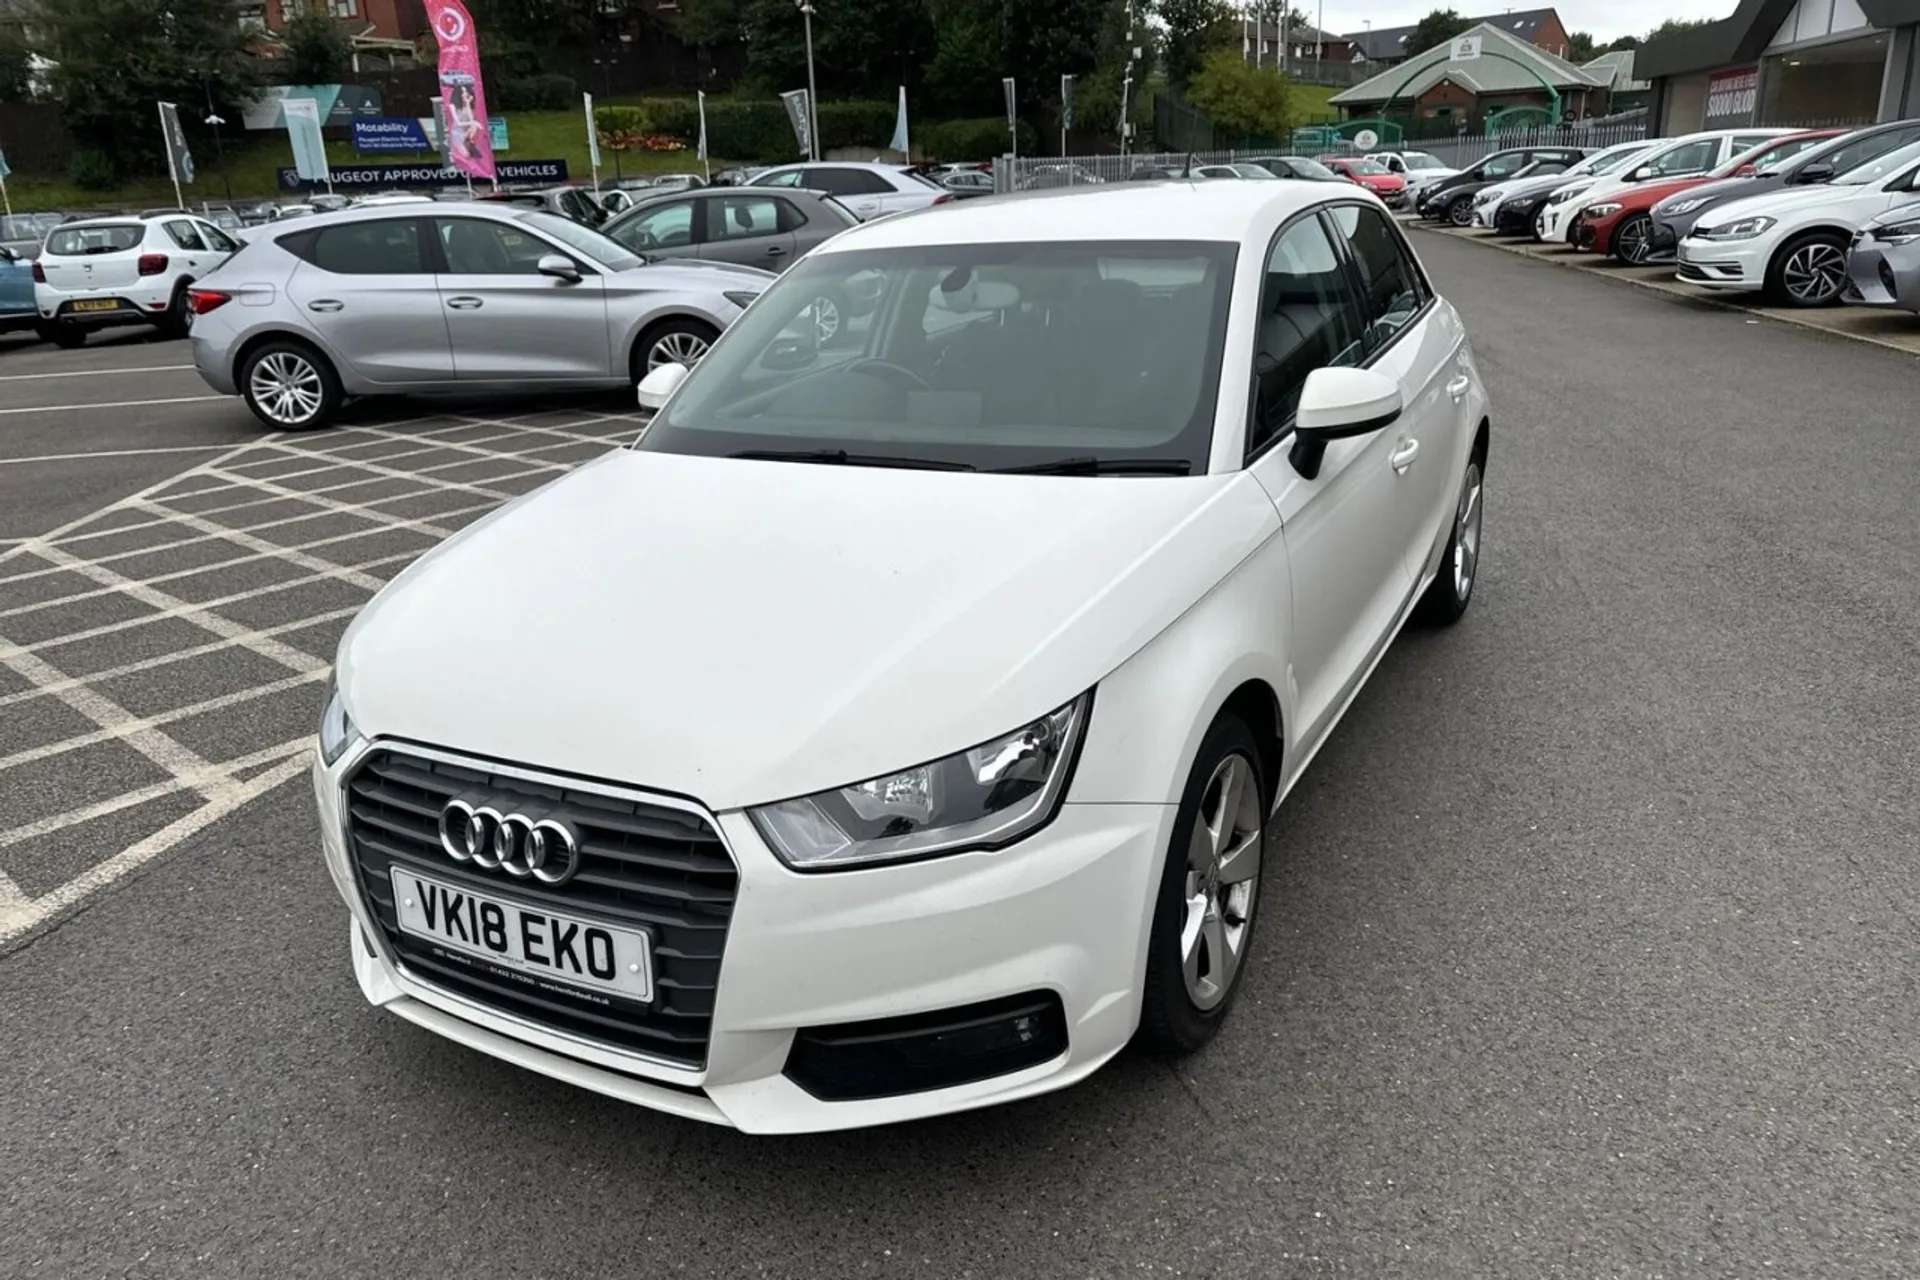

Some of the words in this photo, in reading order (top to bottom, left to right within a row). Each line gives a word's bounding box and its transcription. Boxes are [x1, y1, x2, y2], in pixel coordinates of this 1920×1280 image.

[355, 123, 408, 134] Motability
[497, 164, 558, 177] VEHICLES
[416, 880, 508, 953] VK18
[519, 911, 617, 981] EKO
